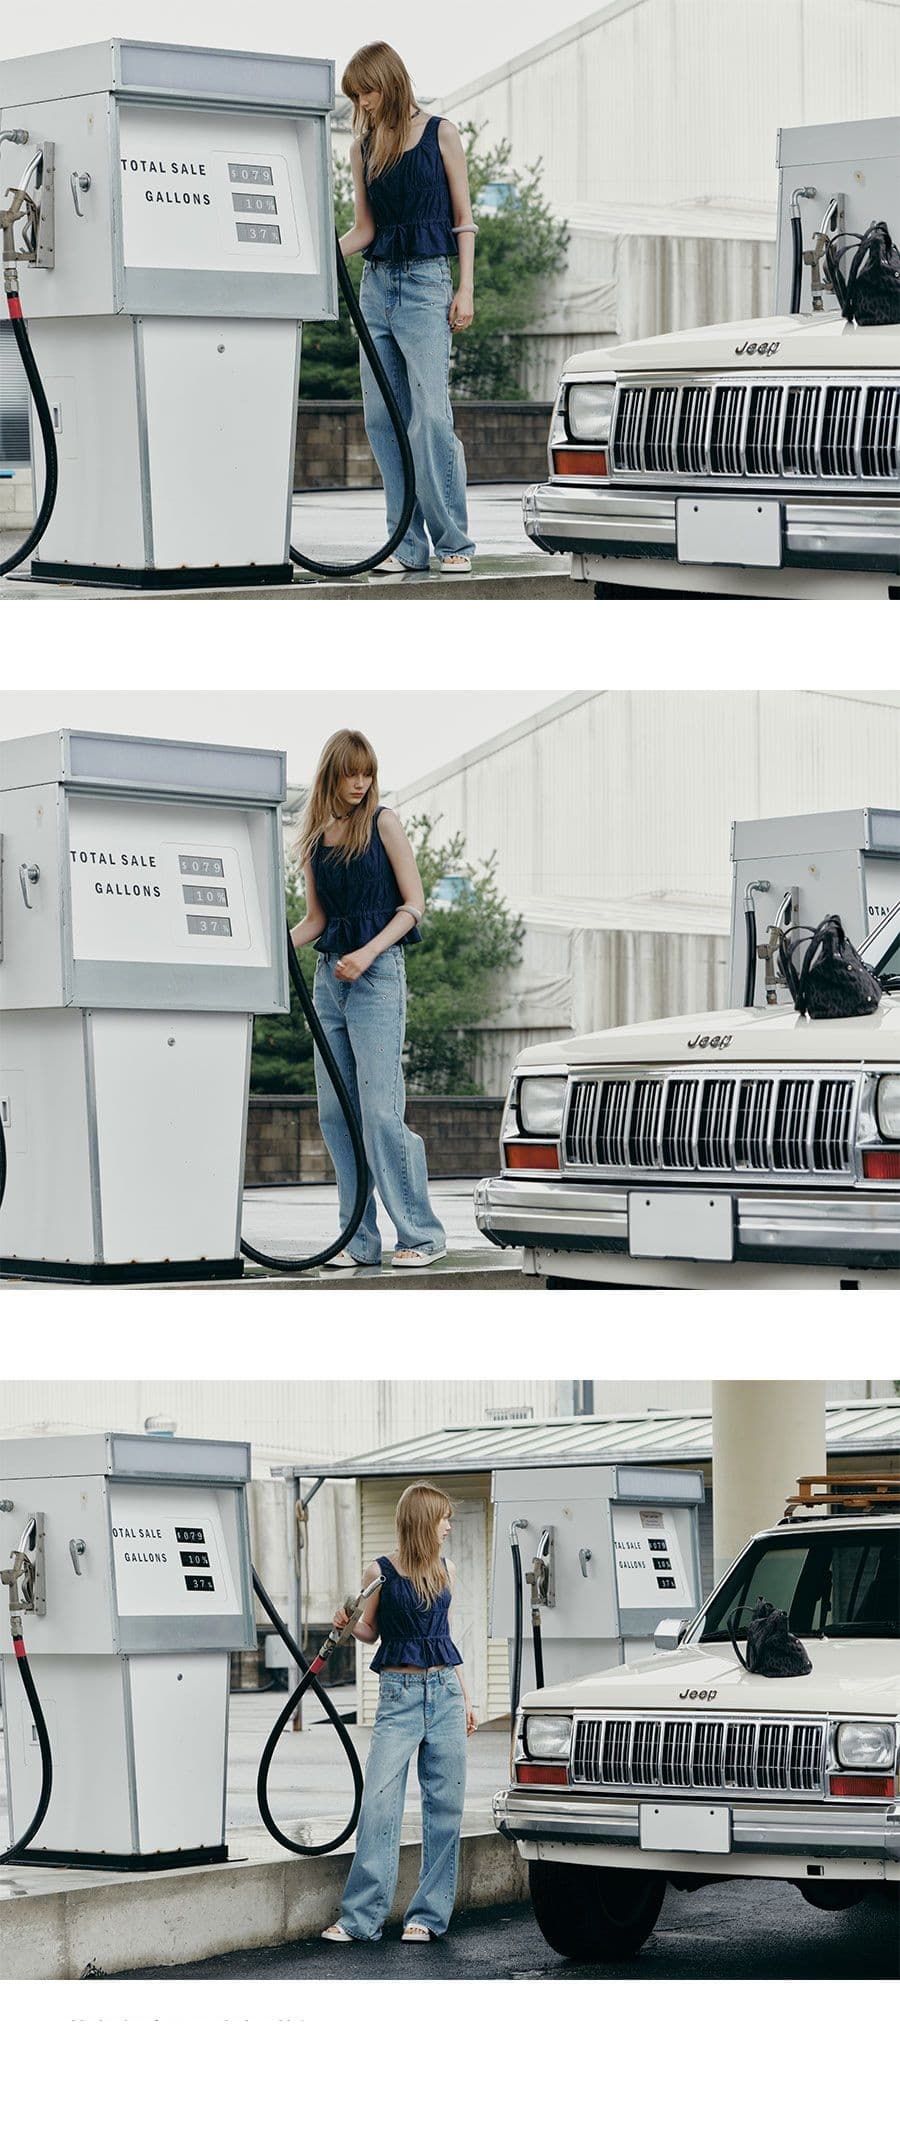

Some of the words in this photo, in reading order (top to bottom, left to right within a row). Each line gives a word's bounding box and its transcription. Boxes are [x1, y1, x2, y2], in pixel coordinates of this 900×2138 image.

[121, 159, 166, 173] TOTAL
[171, 162, 206, 176] SALE
[145, 190, 210, 205] GALLONS
[735, 341, 781, 357] Jeep
[70, 851, 116, 865] TOTAL
[121, 854, 156, 868] SALE
[95, 882, 161, 898] GALLONS
[687, 1034, 733, 1051] Jeep
[139, 1528, 162, 1539] SALE
[627, 1542, 641, 1550] SALE
[124, 1552, 168, 1563] GALLONS
[619, 1561, 646, 1569] GALLONS
[679, 1689, 718, 1702] Jeep
